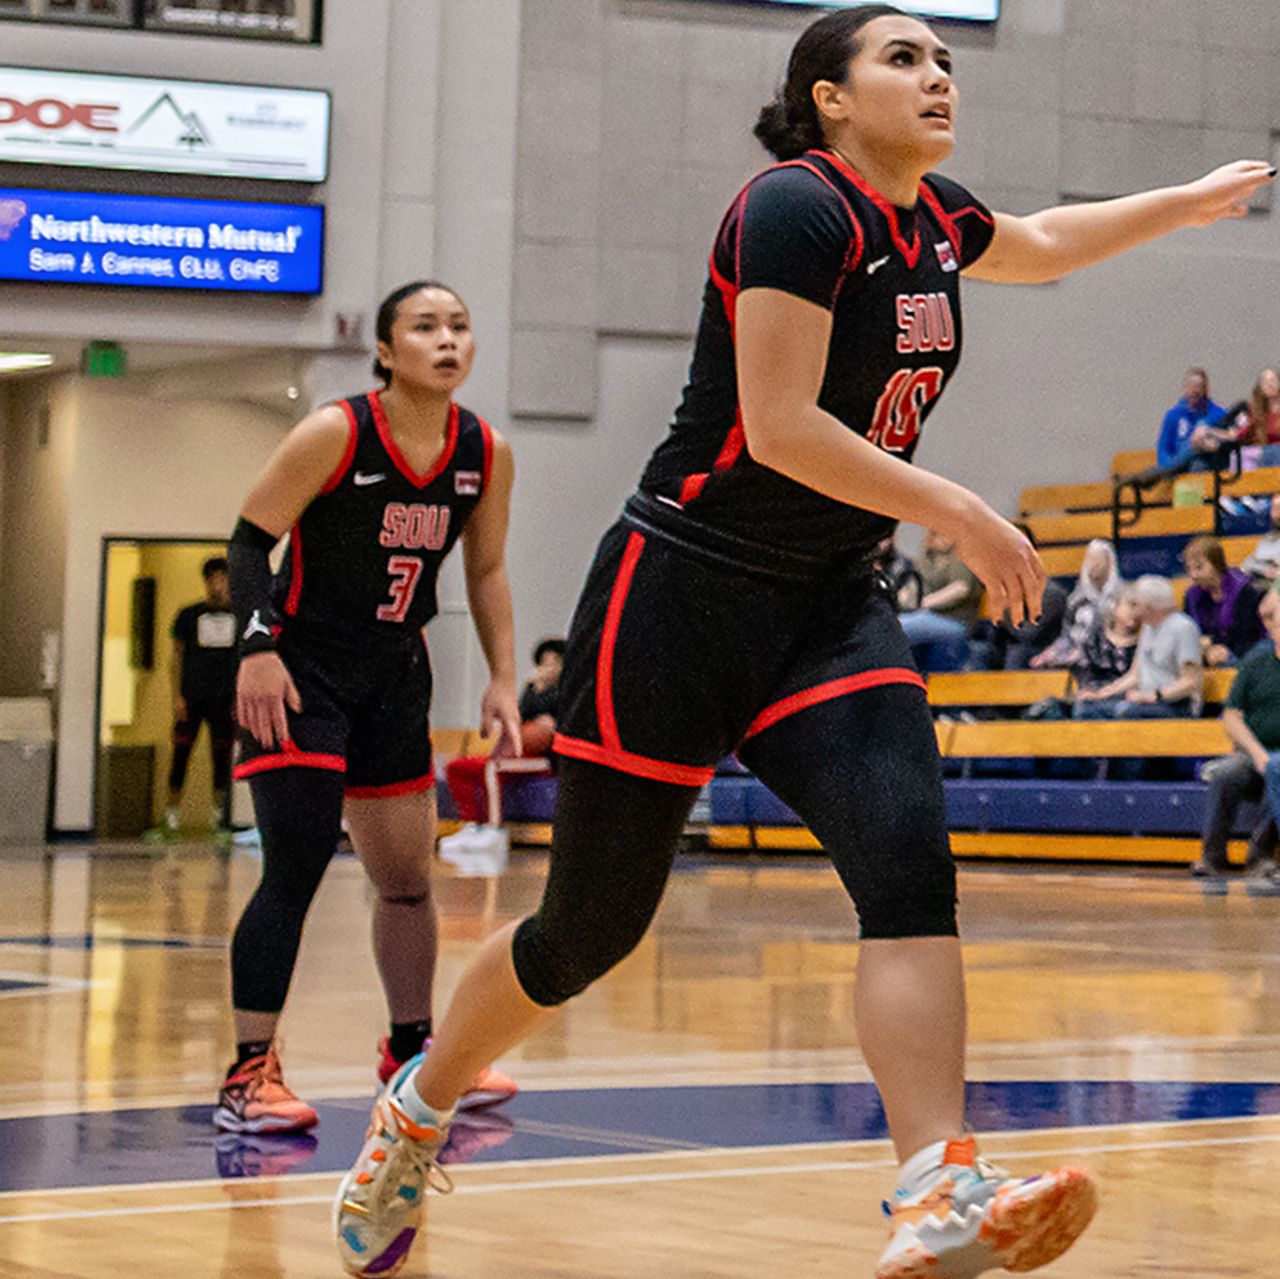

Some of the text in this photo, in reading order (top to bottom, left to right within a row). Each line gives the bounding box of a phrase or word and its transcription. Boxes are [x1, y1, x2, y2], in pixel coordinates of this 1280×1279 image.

[30, 213, 300, 253] Northwestern Mutual
[29, 247, 75, 272] Sam
[896, 292, 955, 353] SOU
[379, 500, 451, 551] SOU
[376, 554, 424, 623] 3
